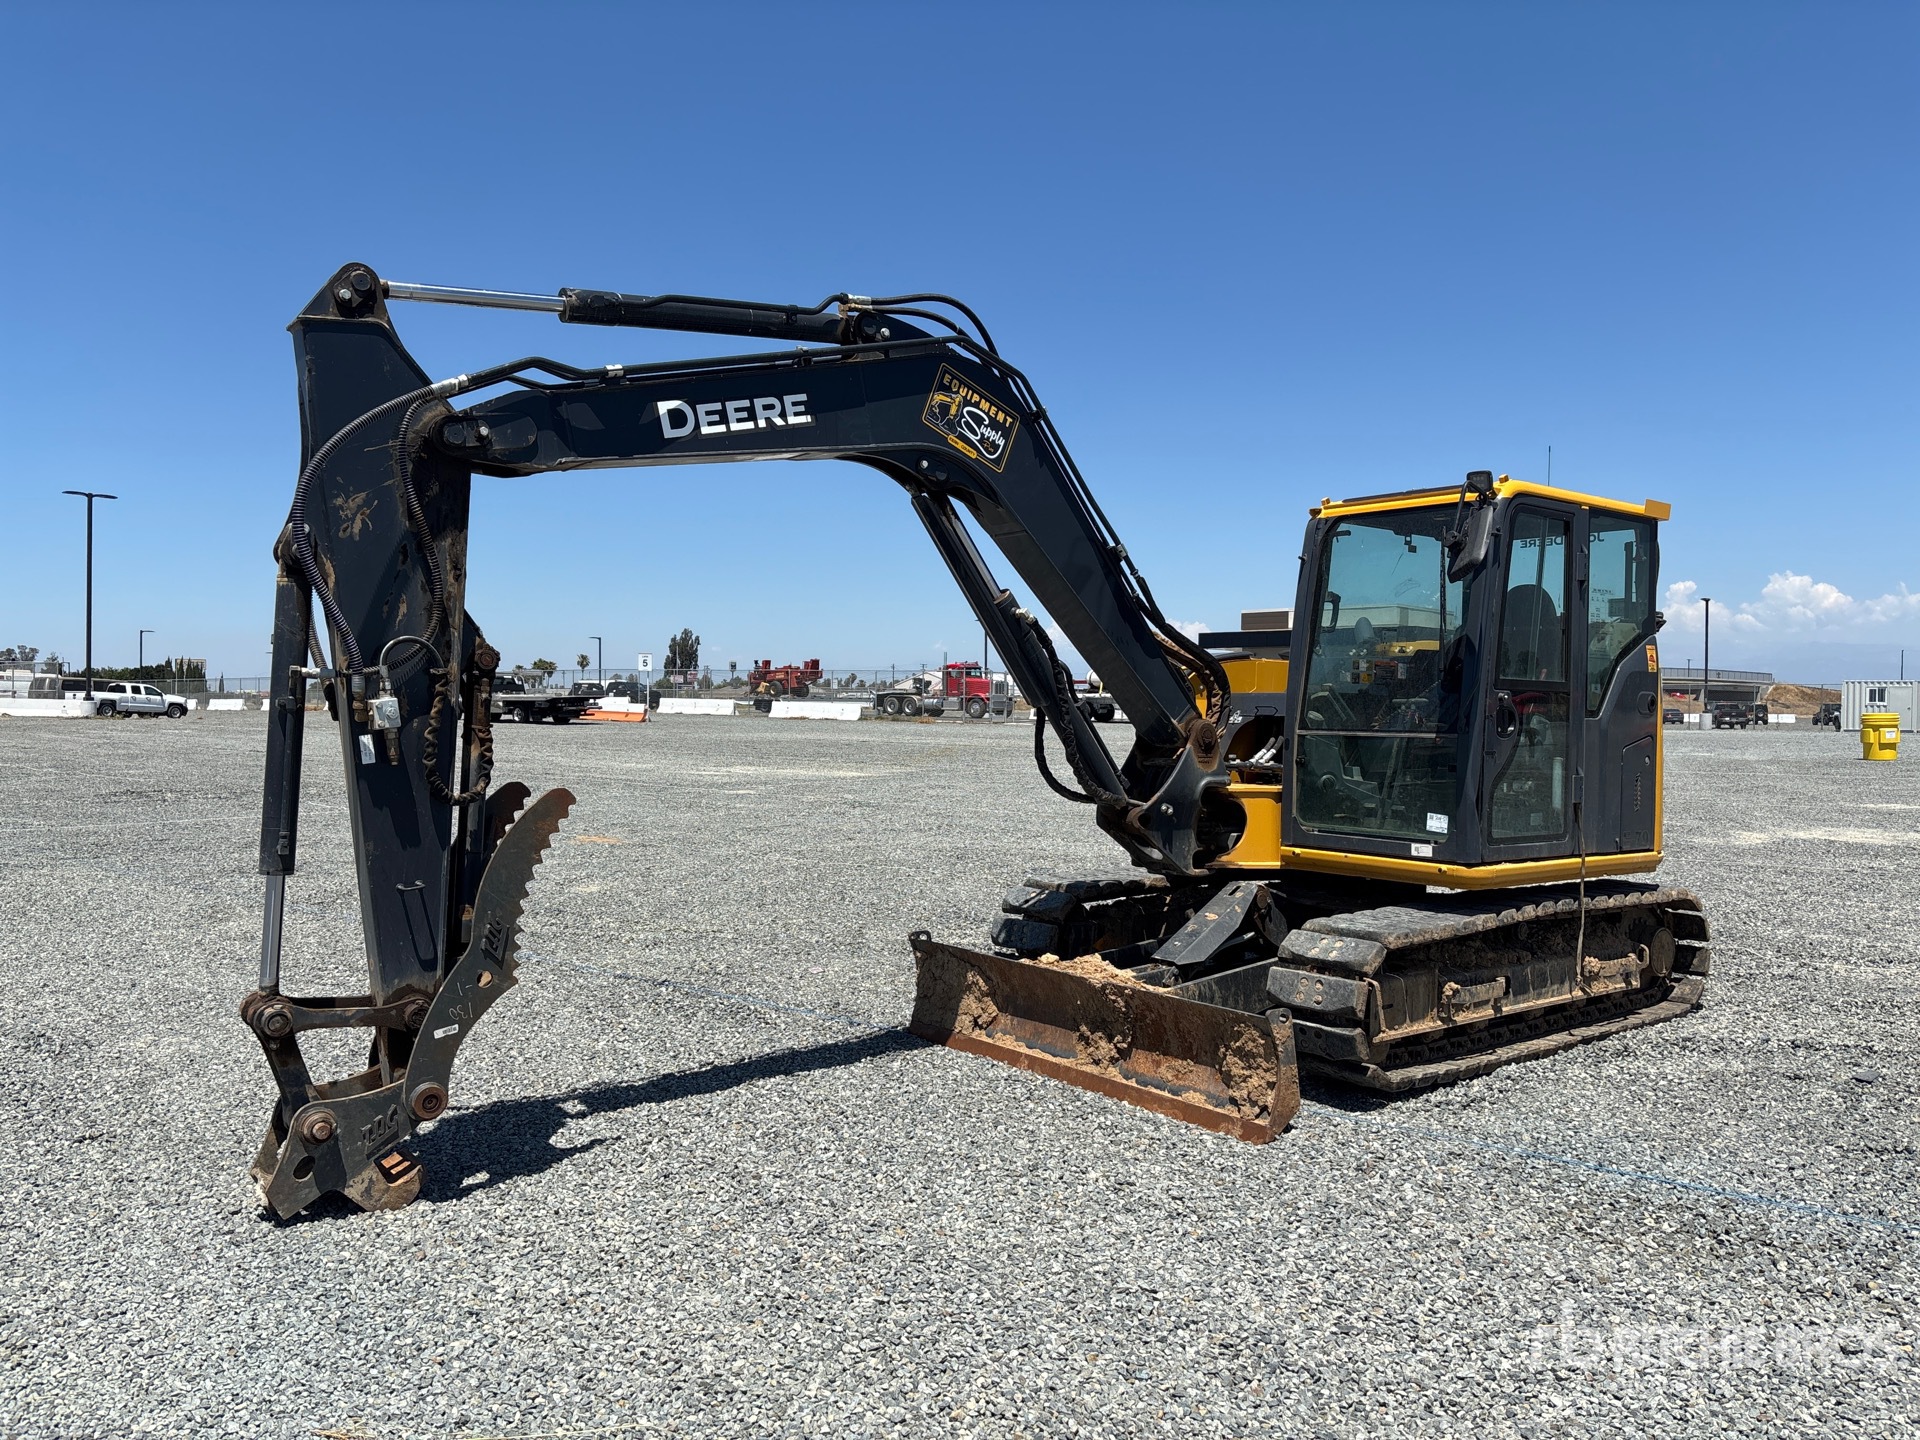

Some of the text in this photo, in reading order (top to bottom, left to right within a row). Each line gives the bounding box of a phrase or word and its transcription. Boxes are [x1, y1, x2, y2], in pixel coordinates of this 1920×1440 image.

[657, 394, 812, 439] DEERE
[943, 373, 1014, 428] EQUIPMENT
[958, 406, 1006, 454] Supply
[642, 658, 649, 668] 5
